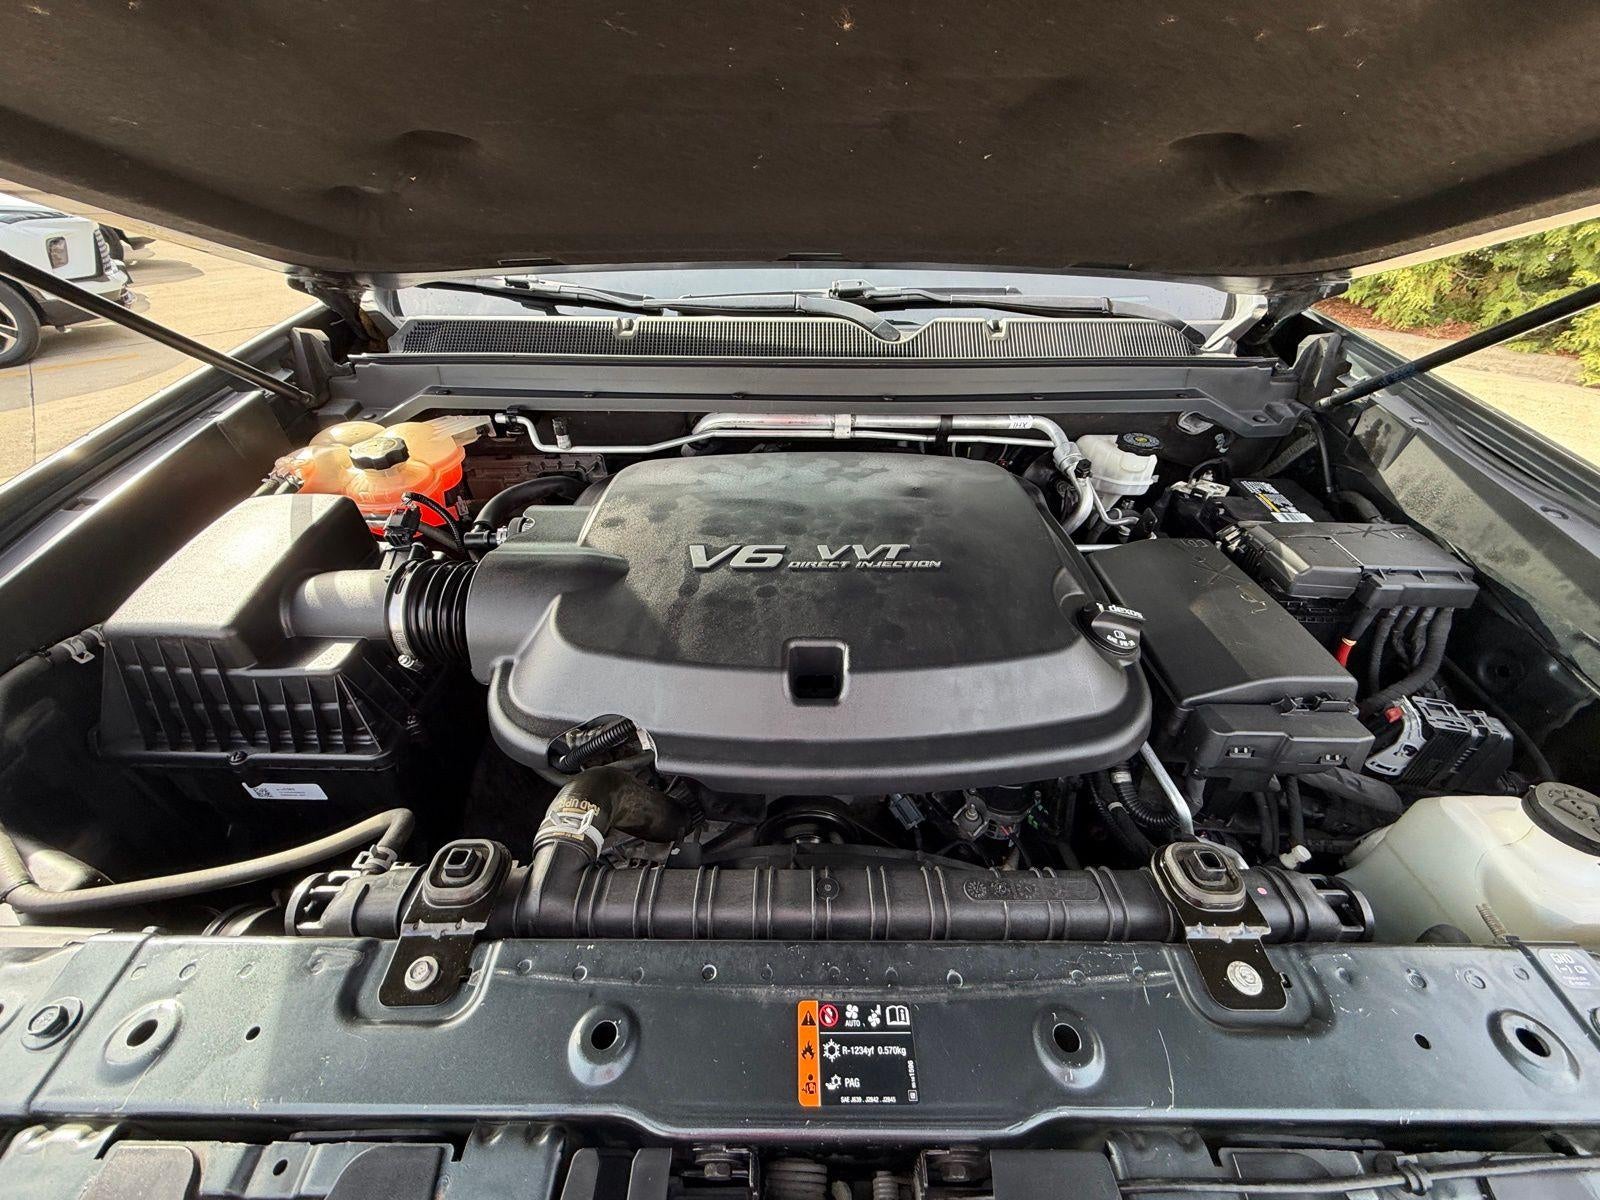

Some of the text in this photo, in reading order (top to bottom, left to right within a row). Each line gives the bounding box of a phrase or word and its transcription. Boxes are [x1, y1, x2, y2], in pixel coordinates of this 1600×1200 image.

[689, 543, 911, 569] V6 VVT
[788, 560, 942, 569] DIRECT INJECTION
[1549, 952, 1576, 964] GND
[845, 1019, 861, 1027] AUTO
[841, 1045, 907, 1057] R-1234yf 0.570kg
[844, 1077, 861, 1088] PAG
